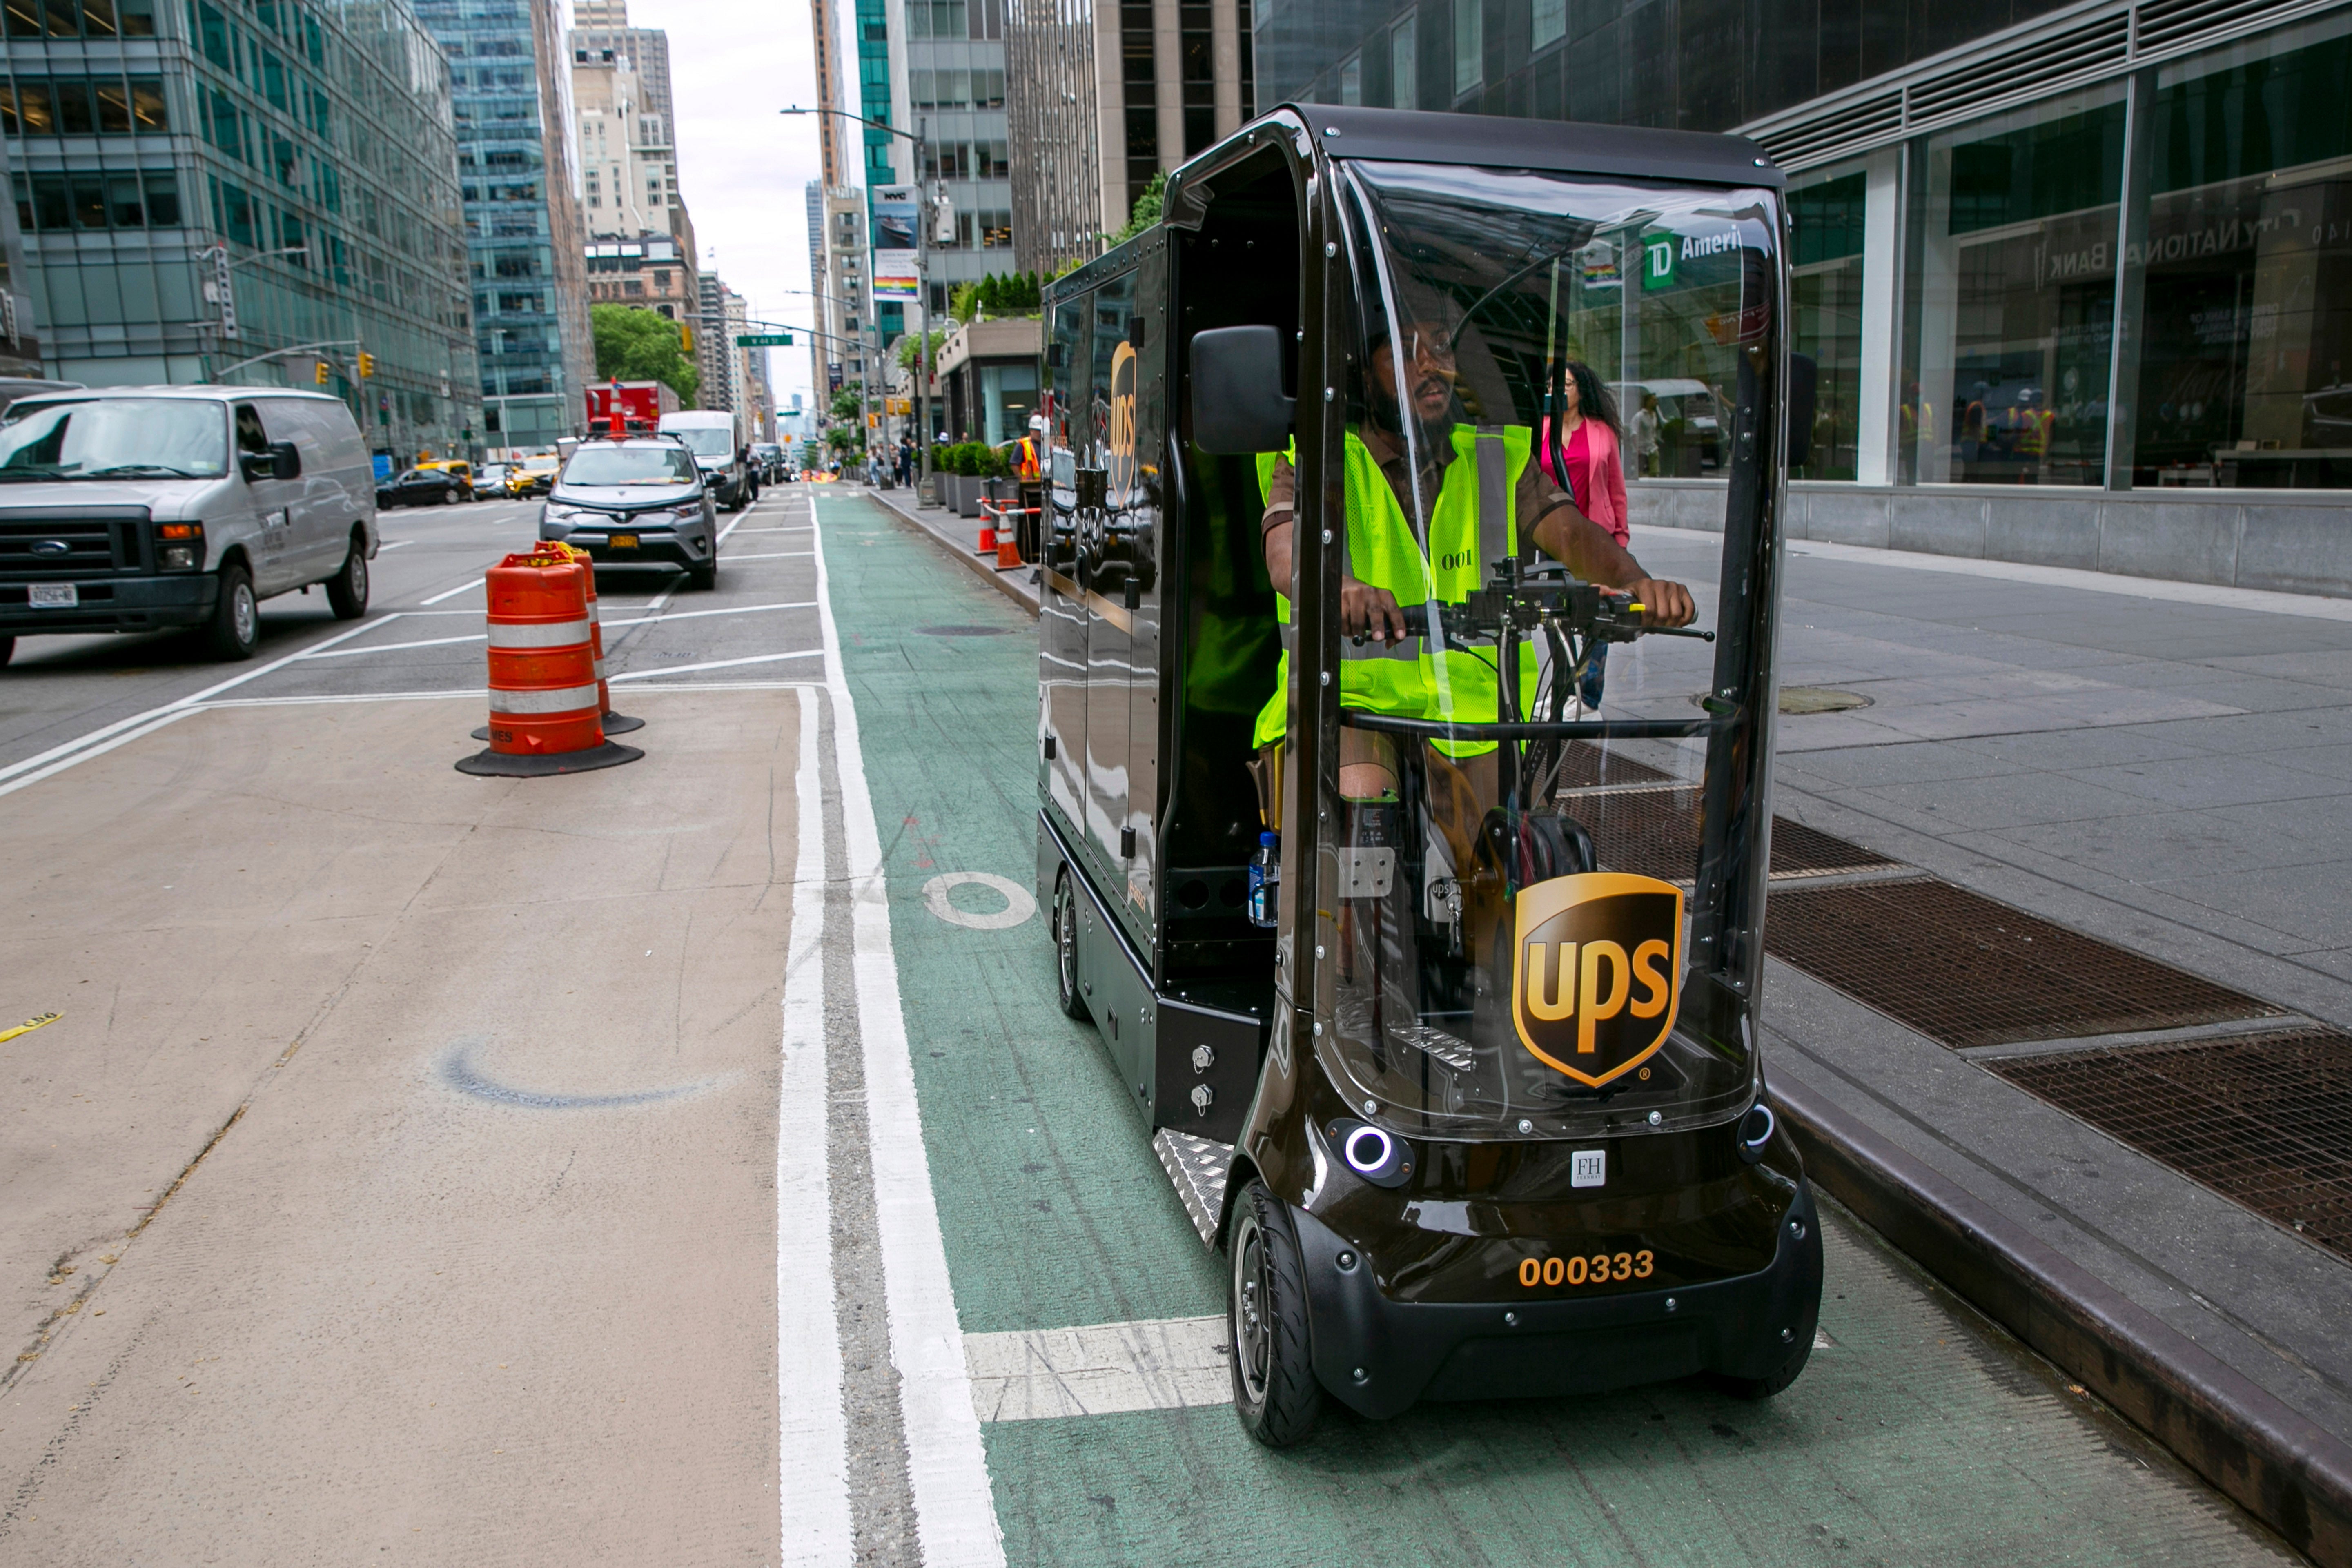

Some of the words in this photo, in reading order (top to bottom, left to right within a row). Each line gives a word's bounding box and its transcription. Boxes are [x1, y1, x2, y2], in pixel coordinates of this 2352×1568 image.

[884, 192, 906, 200] NYC
[1648, 242, 1672, 277] TD
[1113, 394, 1134, 482] ups
[1441, 550, 1471, 570] 001
[1432, 884, 1449, 897] ups
[1528, 940, 1669, 1054] ups
[1577, 1158, 1601, 1175] FH
[1519, 1250, 1653, 1286] 000333
